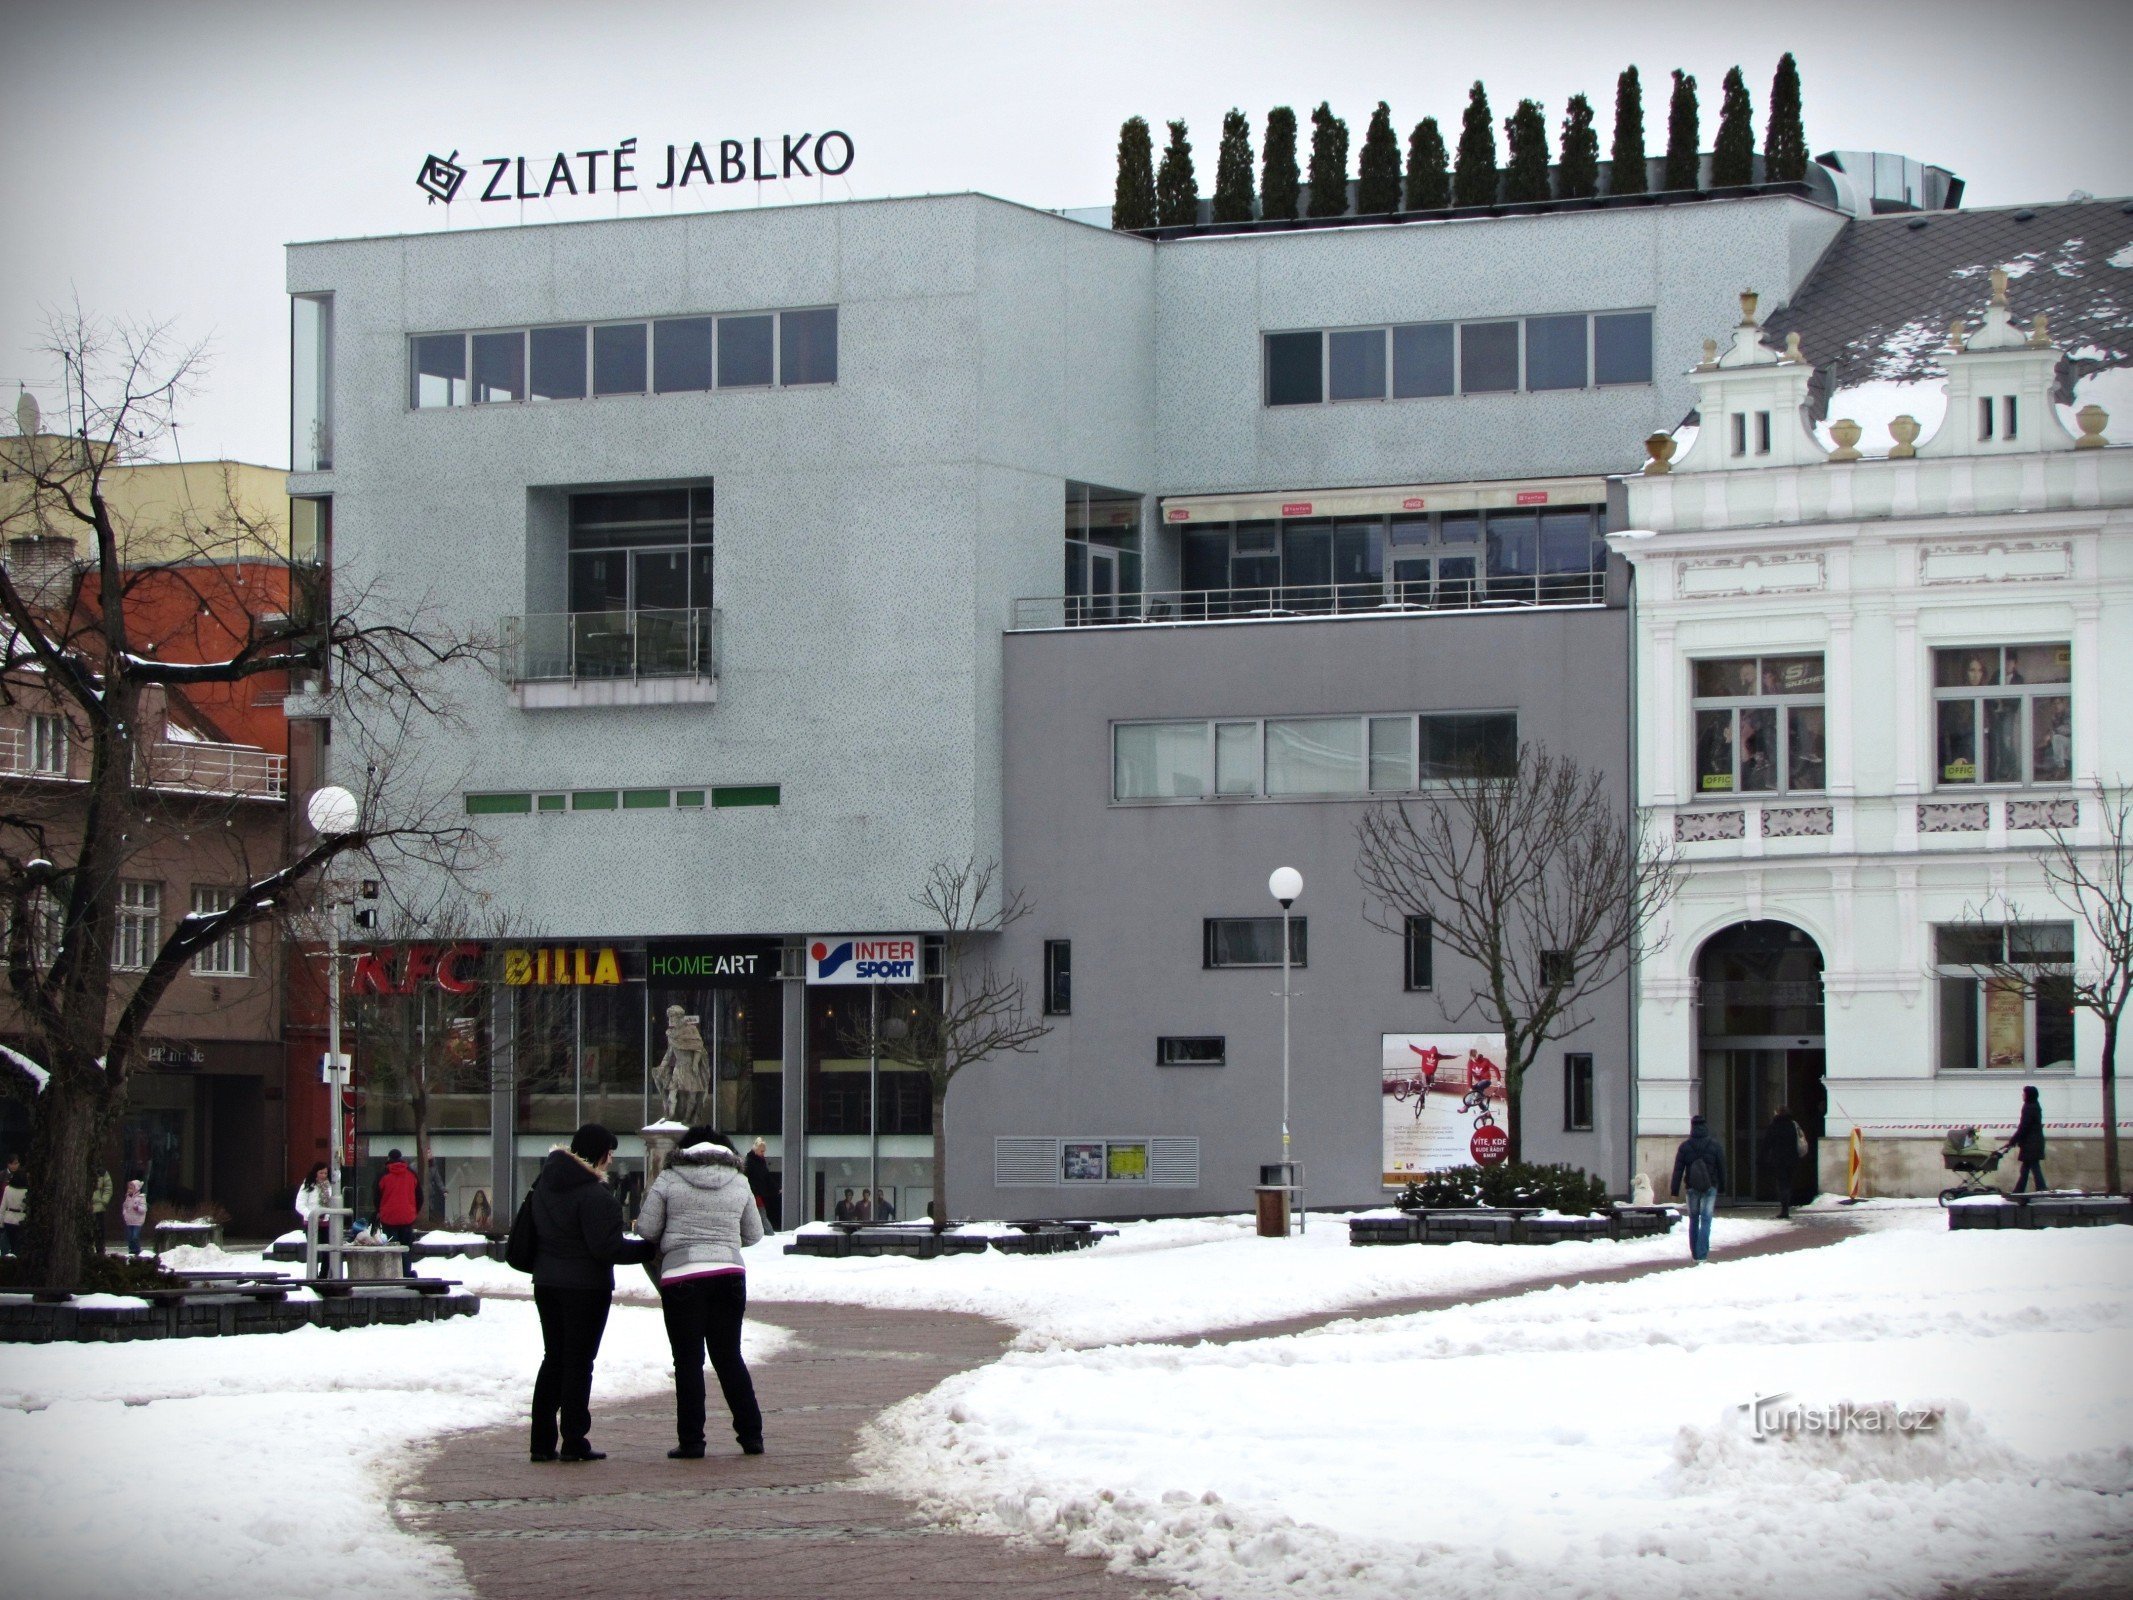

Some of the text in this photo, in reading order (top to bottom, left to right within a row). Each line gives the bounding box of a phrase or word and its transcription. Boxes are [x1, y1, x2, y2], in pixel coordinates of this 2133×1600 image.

[480, 130, 855, 202] ZLATÉ JABLKO
[855, 941, 915, 960] INTER
[346, 939, 482, 995] KFC
[504, 947, 622, 985] BILLA
[652, 955, 759, 975] HOMEART
[855, 960, 915, 978] SPORT
[1492, 1138, 1507, 1146] KDE
